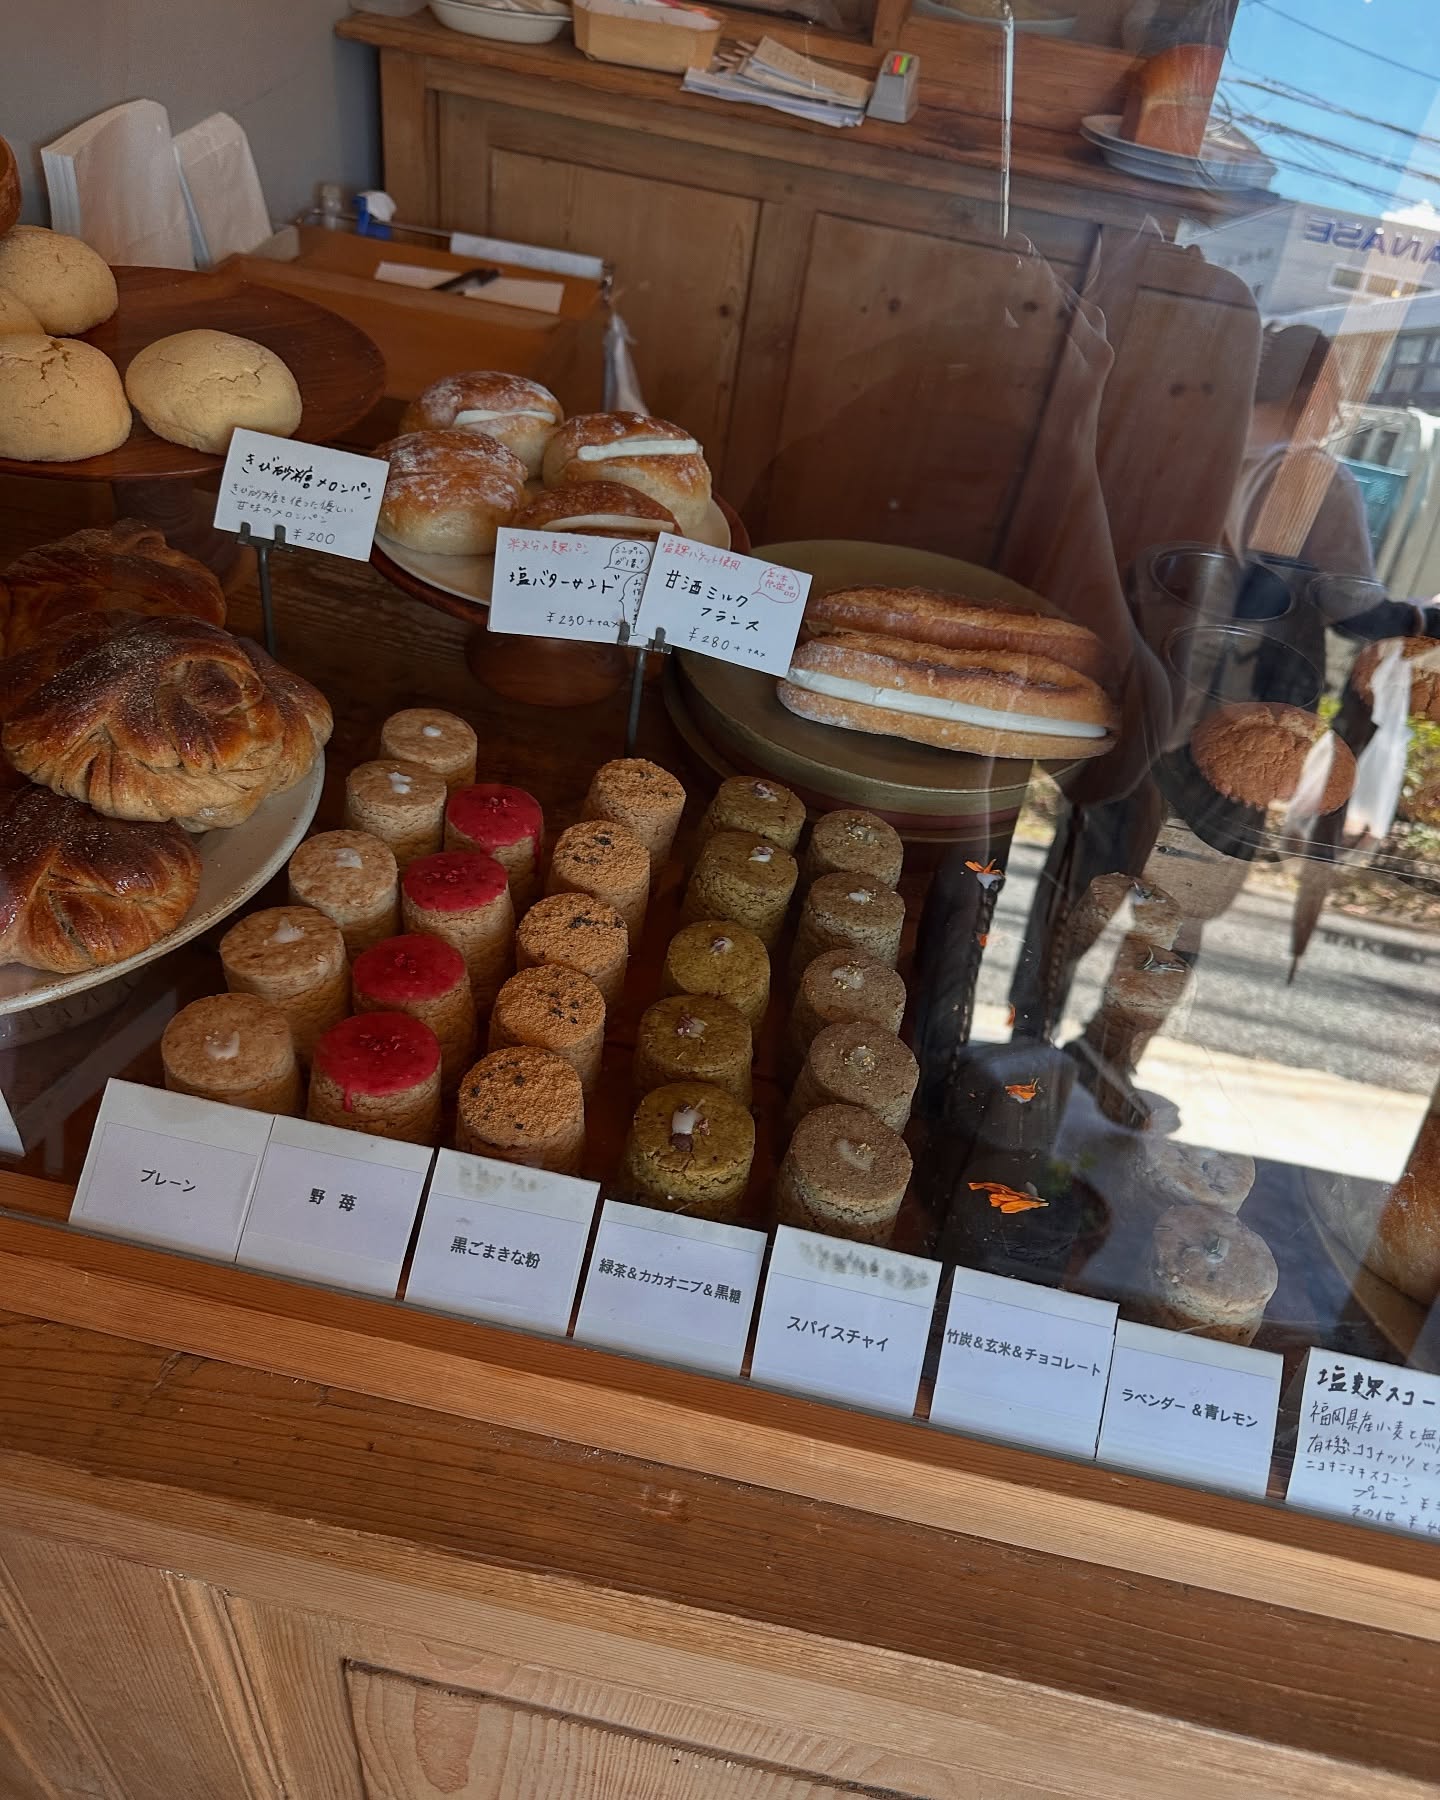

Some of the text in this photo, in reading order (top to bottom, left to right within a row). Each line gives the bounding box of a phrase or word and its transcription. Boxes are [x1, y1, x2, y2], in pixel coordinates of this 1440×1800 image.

[508, 566, 620, 594] 塩バターサンド
[665, 569, 749, 608] 甘酒ミルク
[700, 606, 760, 632] フランス
[140, 1168, 196, 1193] プレーン
[450, 1235, 541, 1270] 黒ごまきな粉
[598, 1257, 742, 1304] 緑茶&カカオニブ&黒糖
[786, 1315, 889, 1352] スパイスチャイ
[946, 1328, 1101, 1377] 竹炭&玄米&チョコレート
[1309, 1400, 1440, 1452] 福岡県産小麦と無
[1353, 1485, 1409, 1505] プレーン
[1351, 1504, 1397, 1522] その他
